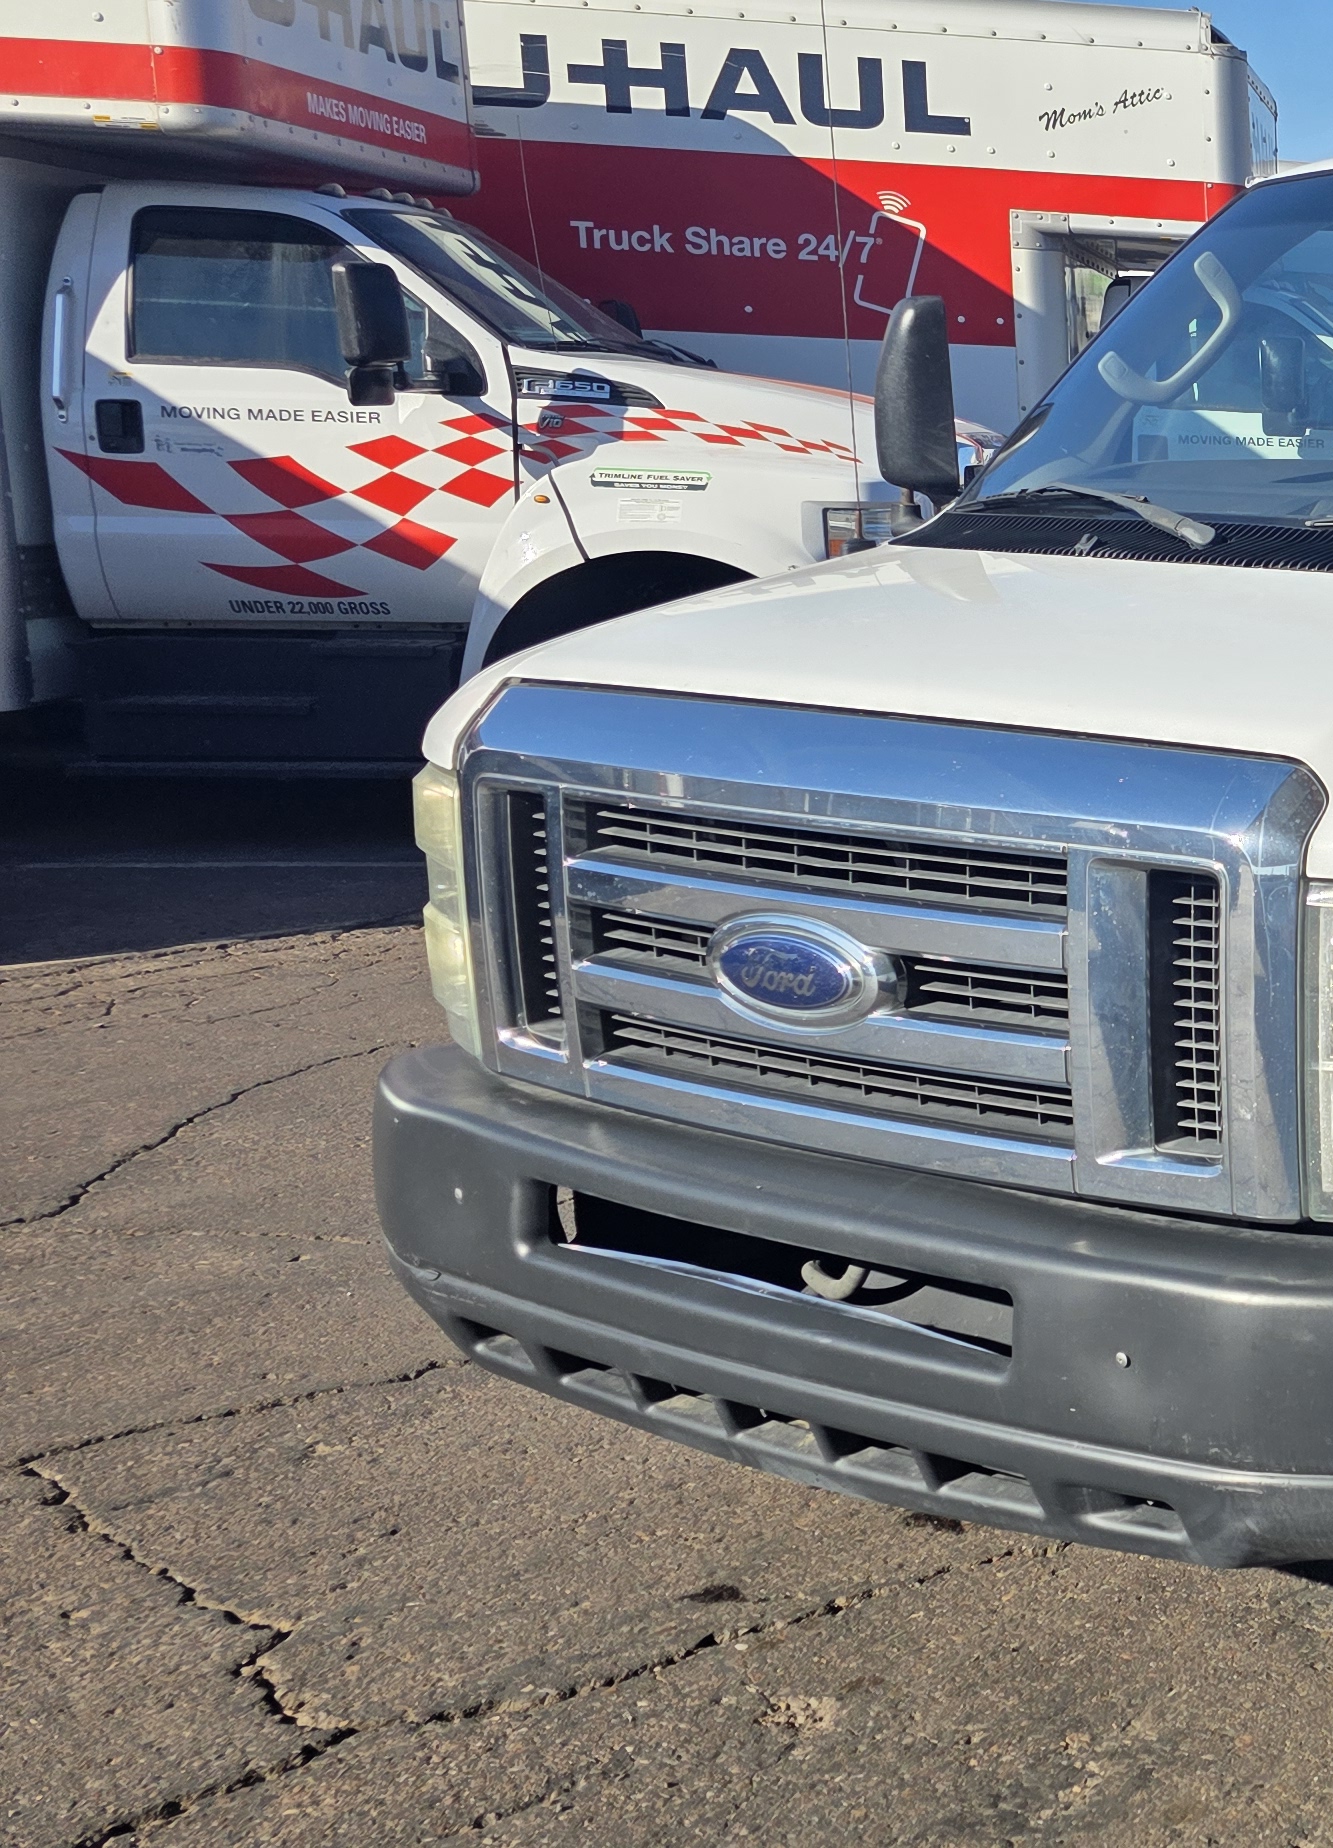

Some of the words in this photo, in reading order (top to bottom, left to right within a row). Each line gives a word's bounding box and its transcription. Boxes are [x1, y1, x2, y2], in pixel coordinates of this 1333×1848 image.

[472, 33, 972, 137] U-HAUL
[306, 91, 347, 123] MAKES
[348, 103, 392, 135] MOVING
[393, 116, 428, 145] EASIER
[1038, 101, 1107, 132] Mom's
[1112, 88, 1164, 114] Attic
[570, 220, 674, 254] Truck
[685, 226, 787, 259] Share
[798, 230, 876, 267] 24/7
[160, 405, 241, 421] MOVING
[247, 408, 305, 422] MADE
[311, 410, 381, 424] EASIER
[1178, 434, 1232, 447] MOVING
[1235, 436, 1274, 448] MADE
[1278, 437, 1325, 449] EASIER
[598, 472, 644, 480] TRIMLINE
[613, 481, 641, 489] SAVES
[228, 599, 286, 615] UNDER
[287, 601, 334, 616] 22,000
[337, 602, 391, 616] GROSS
[740, 947, 818, 998] Ford
